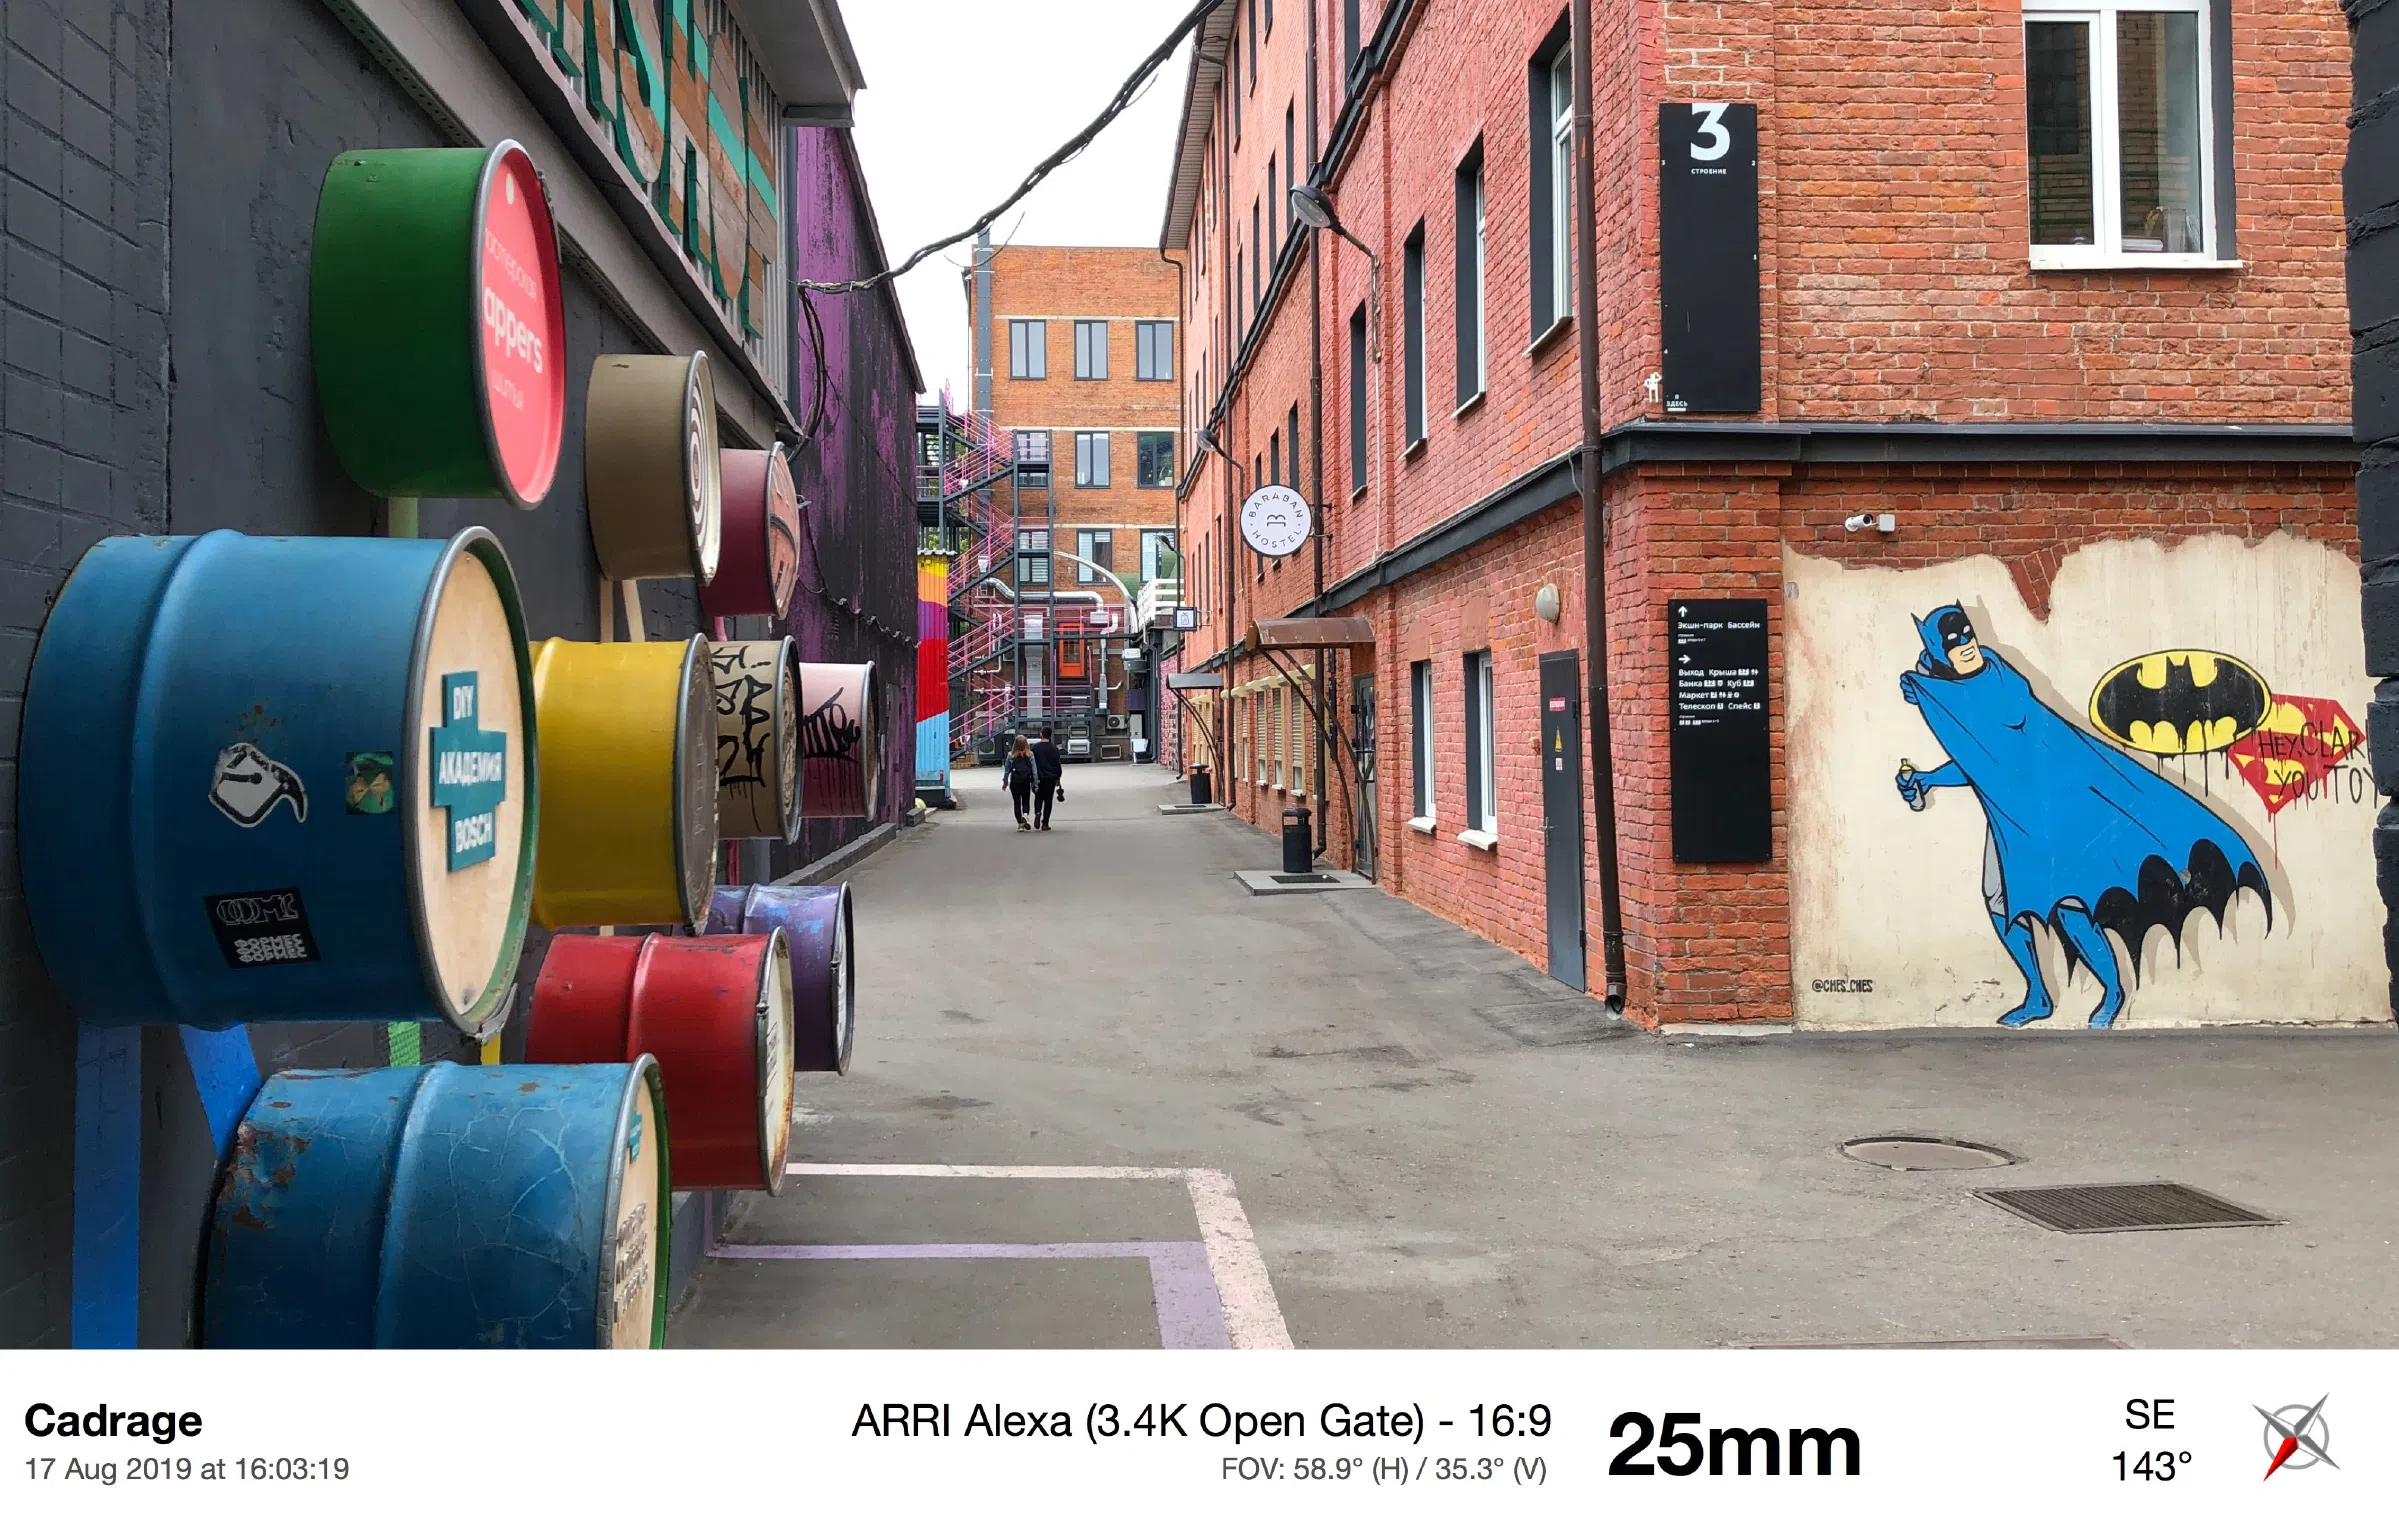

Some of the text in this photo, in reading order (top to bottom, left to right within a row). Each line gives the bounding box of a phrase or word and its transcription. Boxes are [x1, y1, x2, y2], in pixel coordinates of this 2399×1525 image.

[1690, 103, 1731, 161] 3
[483, 285, 543, 375] appers
[1666, 400, 1688, 408] ЗДЕСЬ
[1248, 492, 1304, 518] BARABAN
[1252, 530, 1302, 549] HOSTEL
[1677, 620, 1761, 631] Экшн-парк Бассейн
[1678, 668, 1705, 678] Выход
[1708, 668, 1738, 678] Крыша
[1678, 679, 1703, 688] Банка
[1726, 678, 1742, 689] Куб
[453, 685, 475, 720] DIY
[1678, 691, 1710, 701] Маркет
[1678, 702, 1716, 711] Телескоп
[1727, 701, 1753, 711] Спейс
[438, 751, 503, 788] АКАДЕМИЯ
[2273, 768, 2320, 801] YOU
[454, 811, 493, 854] BOSCH
[1811, 978, 1873, 993] @CHES_CHES
